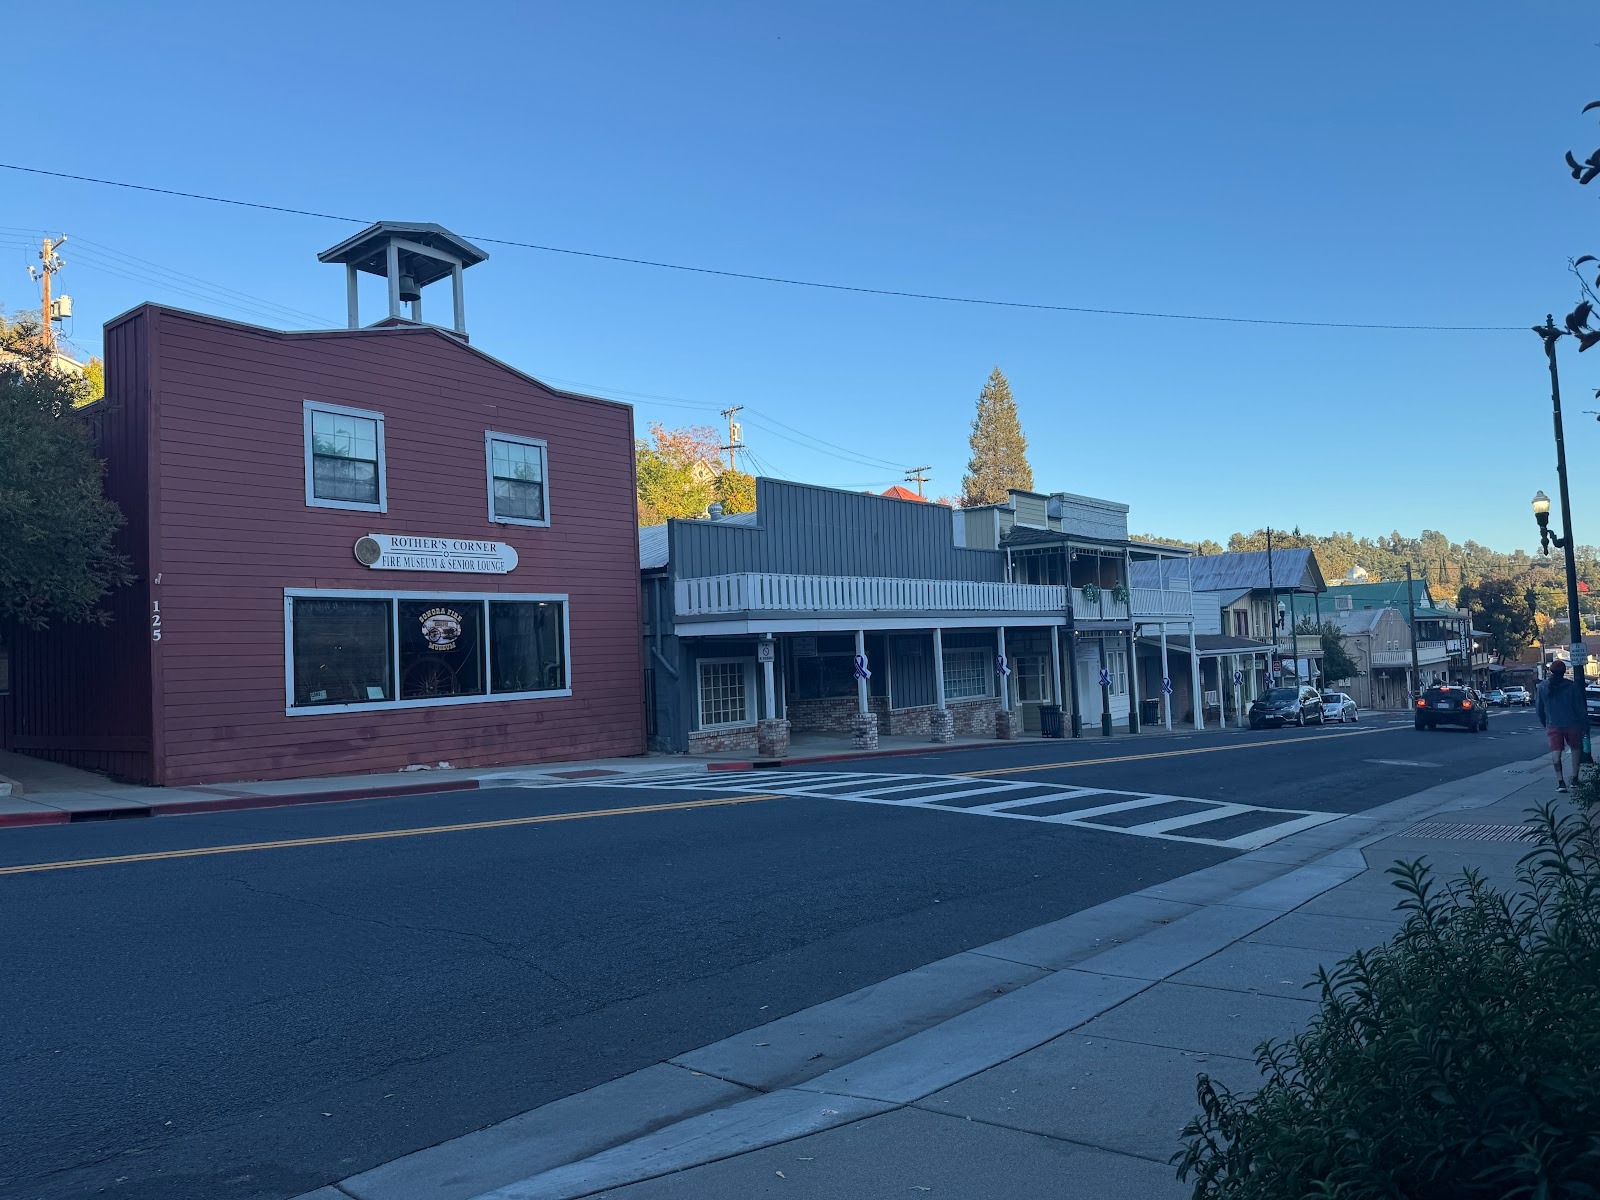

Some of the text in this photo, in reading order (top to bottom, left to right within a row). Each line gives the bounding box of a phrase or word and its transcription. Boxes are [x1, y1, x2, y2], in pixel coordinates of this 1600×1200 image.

[391, 537, 497, 552] ROTHER'S CORNER
[382, 555, 505, 572] FIRE MUSEUM & SENIOR LOUNGE
[152, 600, 162, 641] 125
[418, 607, 463, 623] SONORA FIRE
[428, 641, 457, 651] MUSEUM
